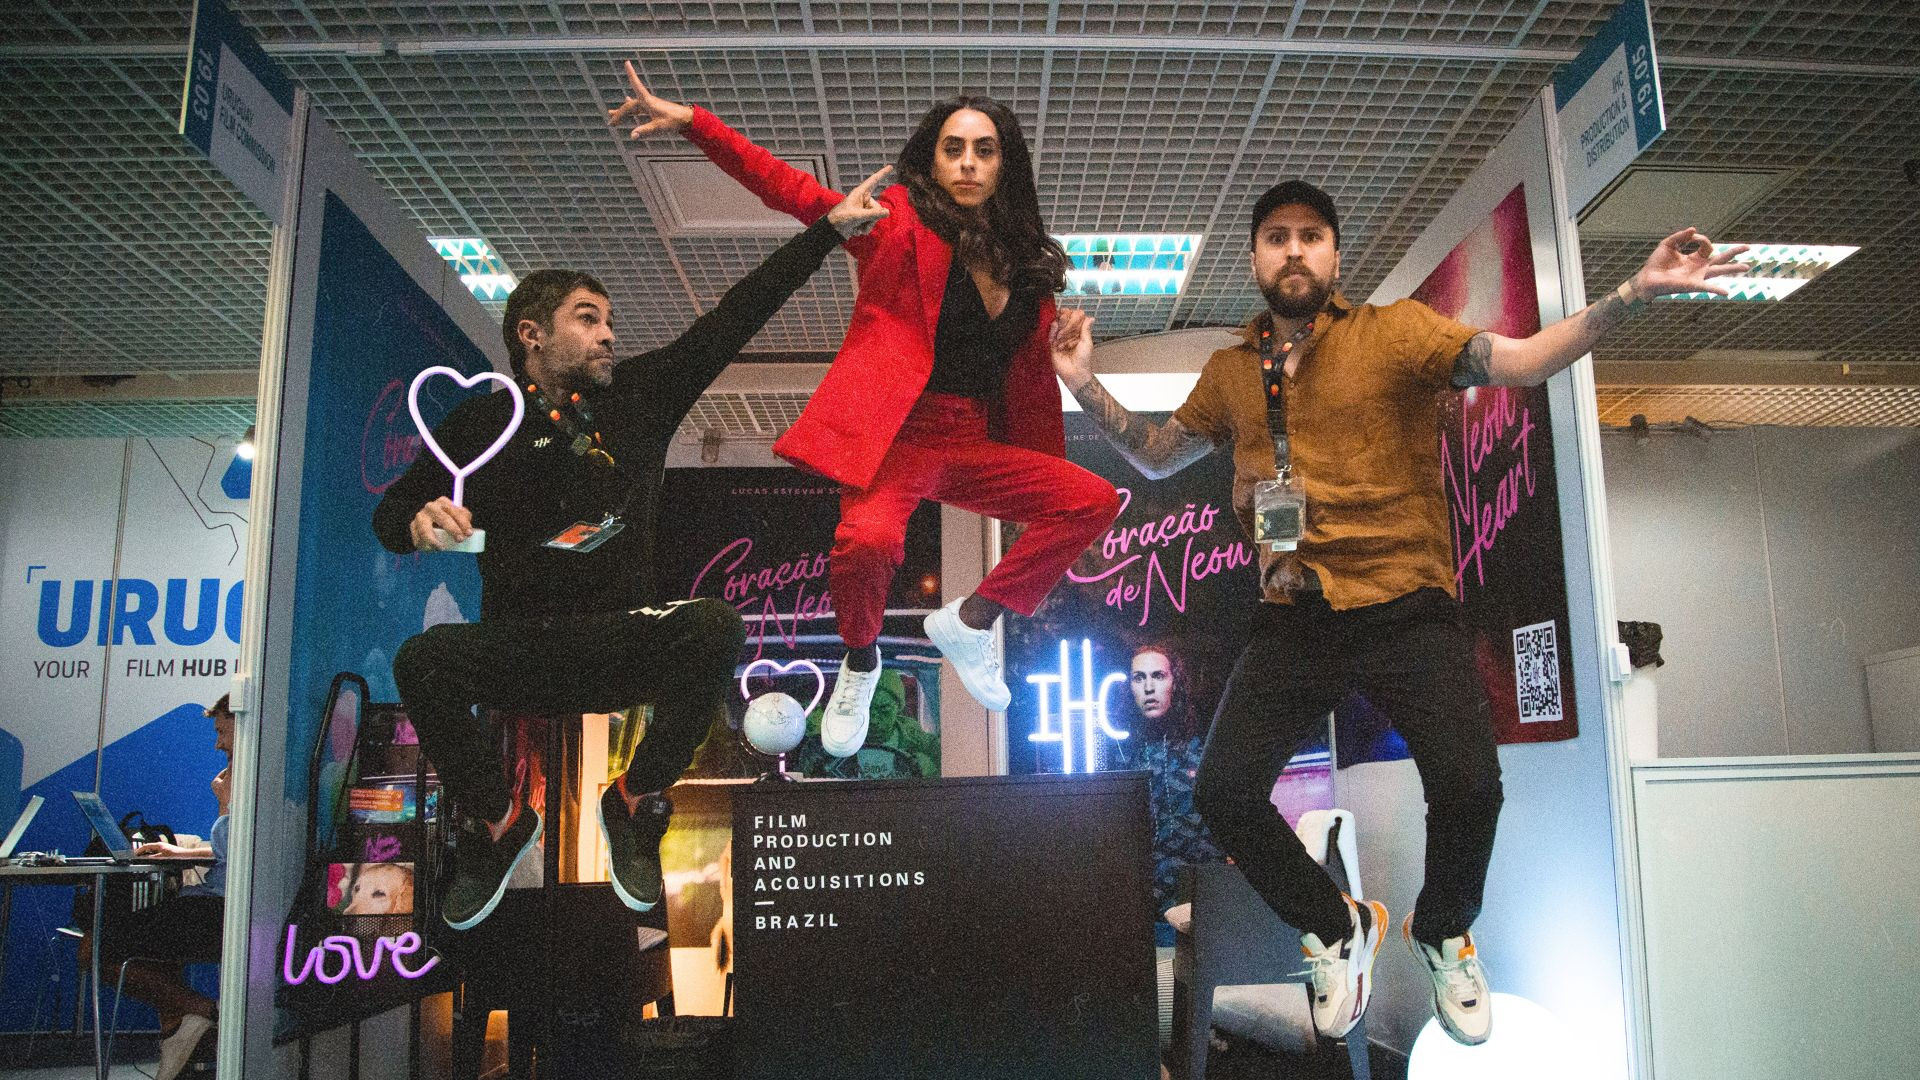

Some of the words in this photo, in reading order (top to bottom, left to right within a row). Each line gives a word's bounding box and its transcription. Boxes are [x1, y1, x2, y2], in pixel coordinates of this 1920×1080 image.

[193, 48, 214, 121] 19.03
[222, 82, 254, 127] URUGUAY
[1612, 70, 1624, 94] IHC
[1632, 44, 1653, 116] 19.05
[219, 105, 236, 136] FILM
[236, 122, 276, 174] COMMISSION
[1580, 98, 1622, 151] PRODUCTION
[1586, 113, 1630, 168] DISTRIBUTION
[731, 487, 769, 495] LUCAS
[773, 487, 824, 495] ESTEVAN
[1452, 407, 1537, 603] Heart
[1105, 575, 1141, 611] de
[1138, 536, 1253, 627] Neon
[753, 582, 833, 661] Neo
[33, 660, 90, 678] YOUR
[126, 659, 174, 677] FILM
[181, 658, 227, 677] HUB
[1025, 638, 1130, 775] IHC
[753, 832, 893, 849] PRODUCTION
[754, 814, 807, 829] FILM
[754, 856, 797, 871] AND
[754, 871, 926, 892] ACQUISITIONS
[755, 913, 839, 930] BRAZIL
